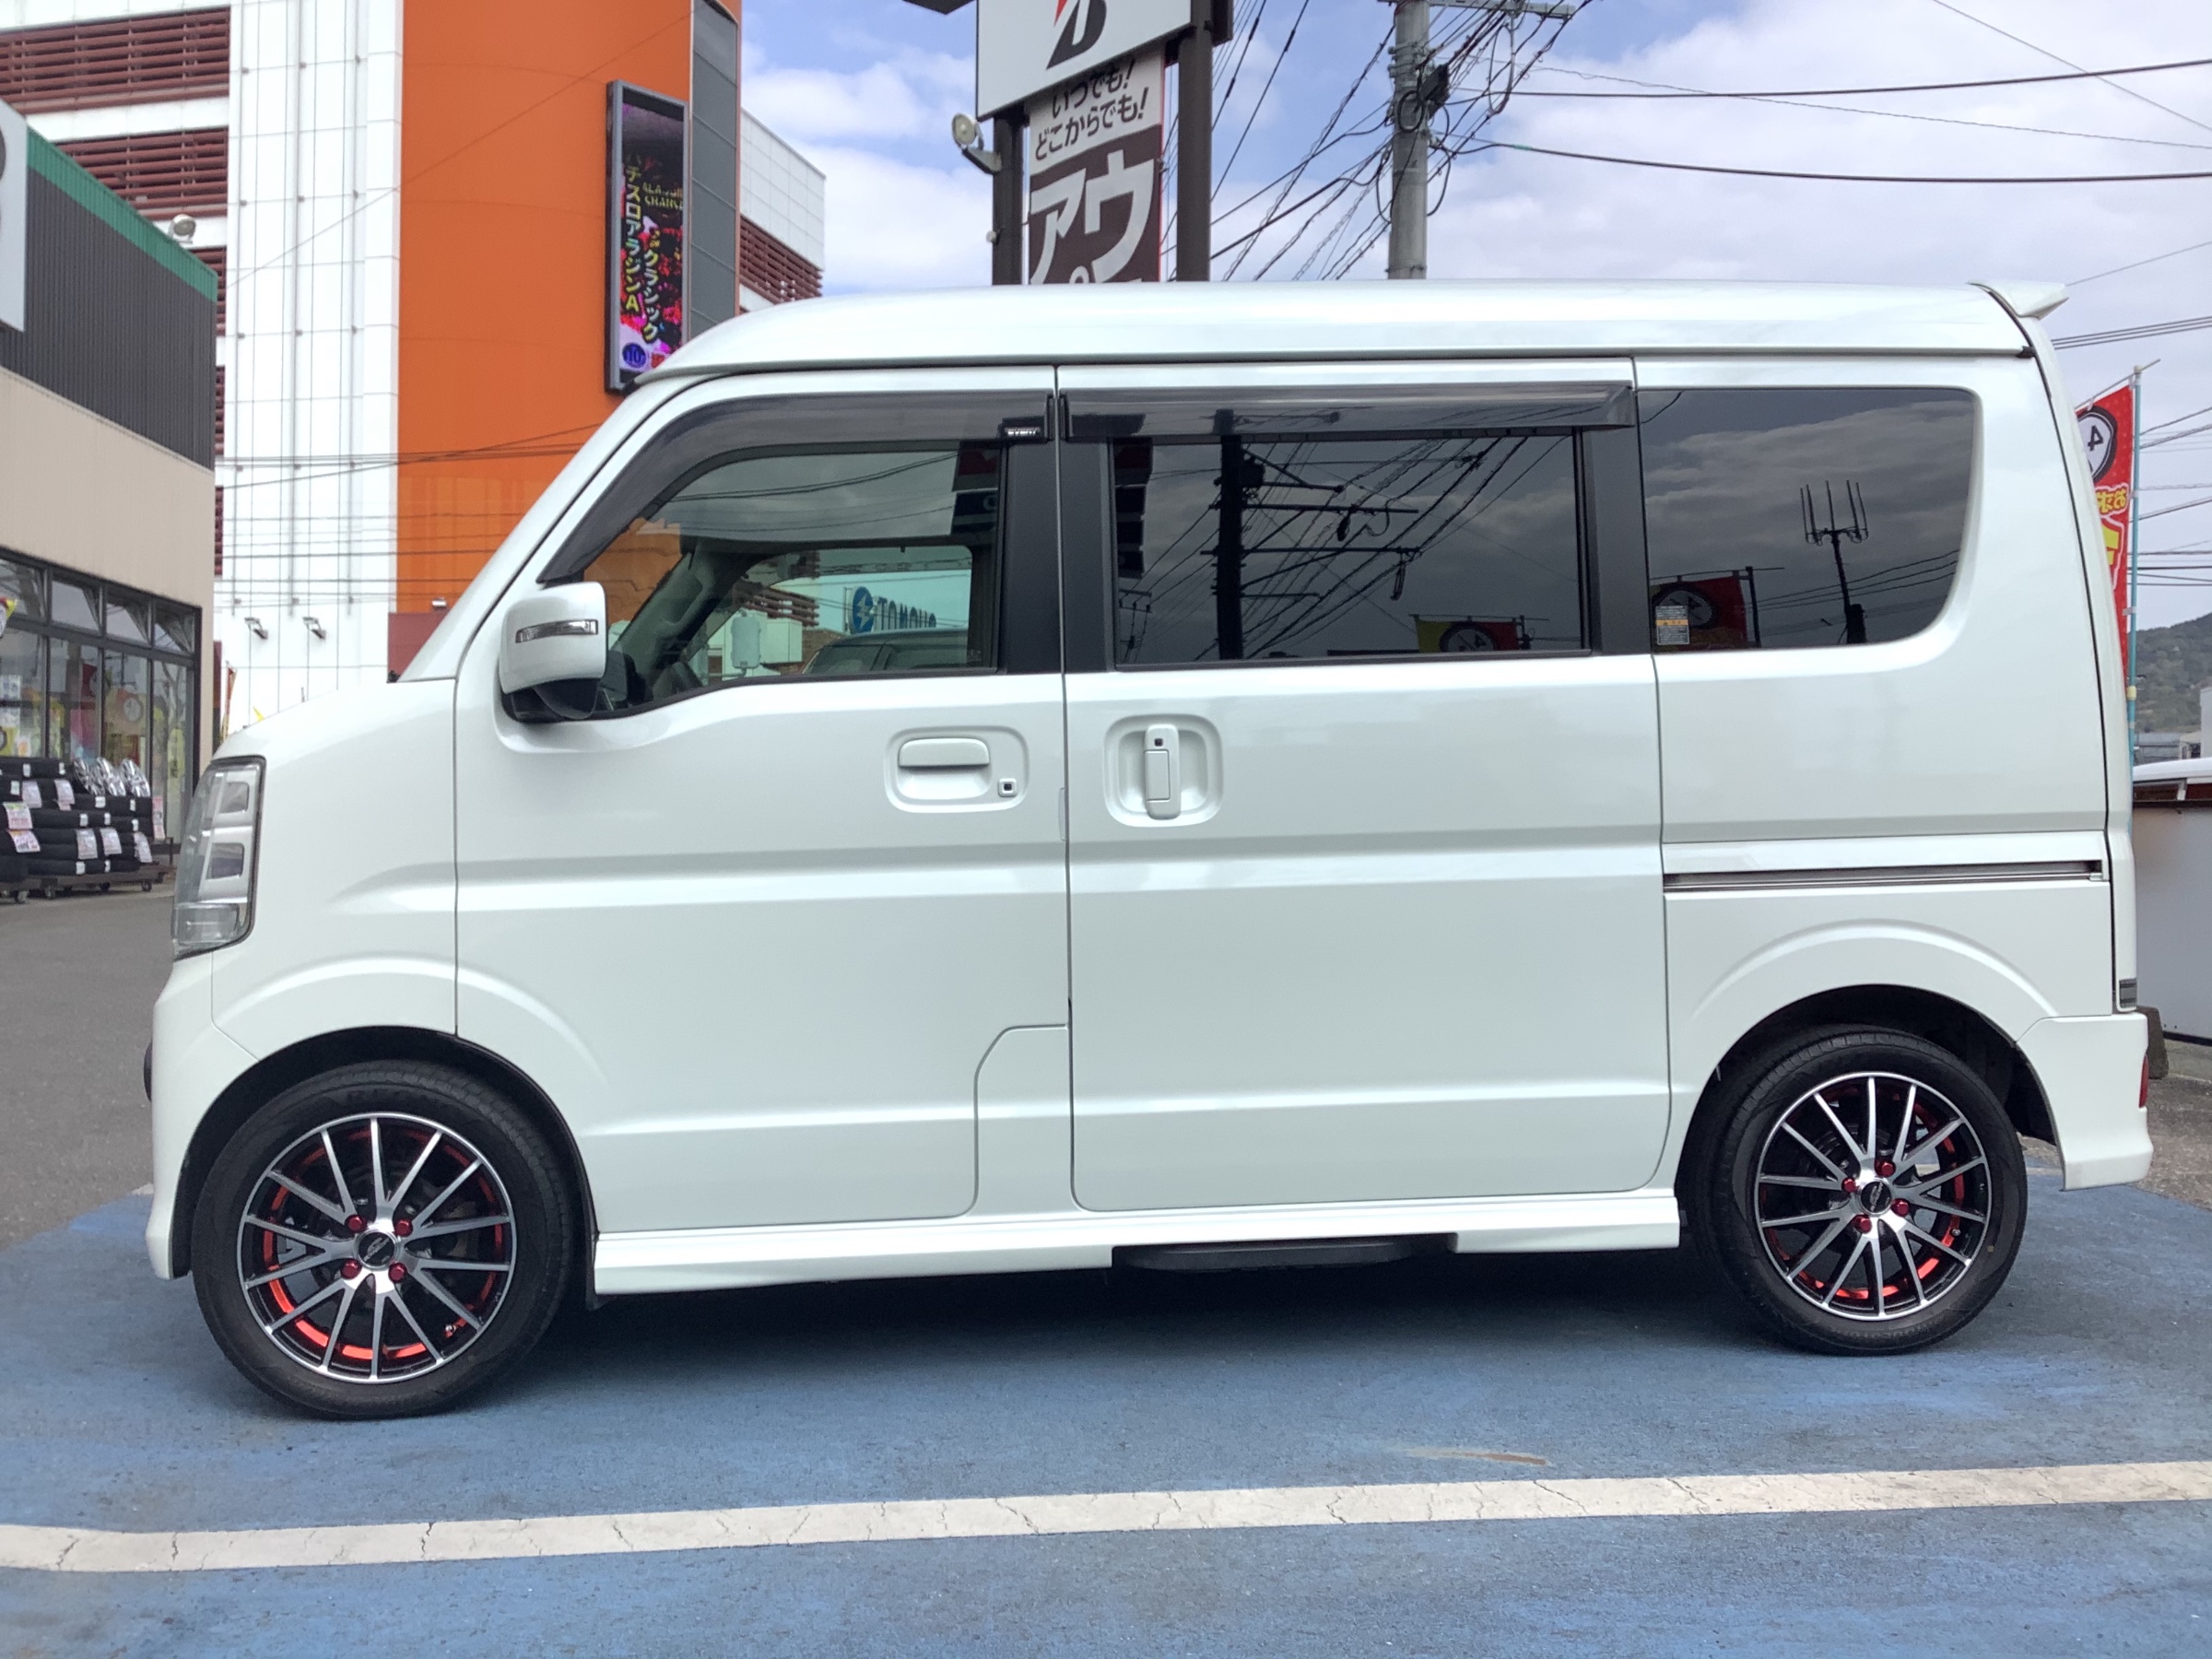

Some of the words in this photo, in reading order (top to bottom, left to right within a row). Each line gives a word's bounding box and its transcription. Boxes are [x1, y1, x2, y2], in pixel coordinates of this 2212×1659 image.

[1035, 87, 1148, 160] どこからでも!
